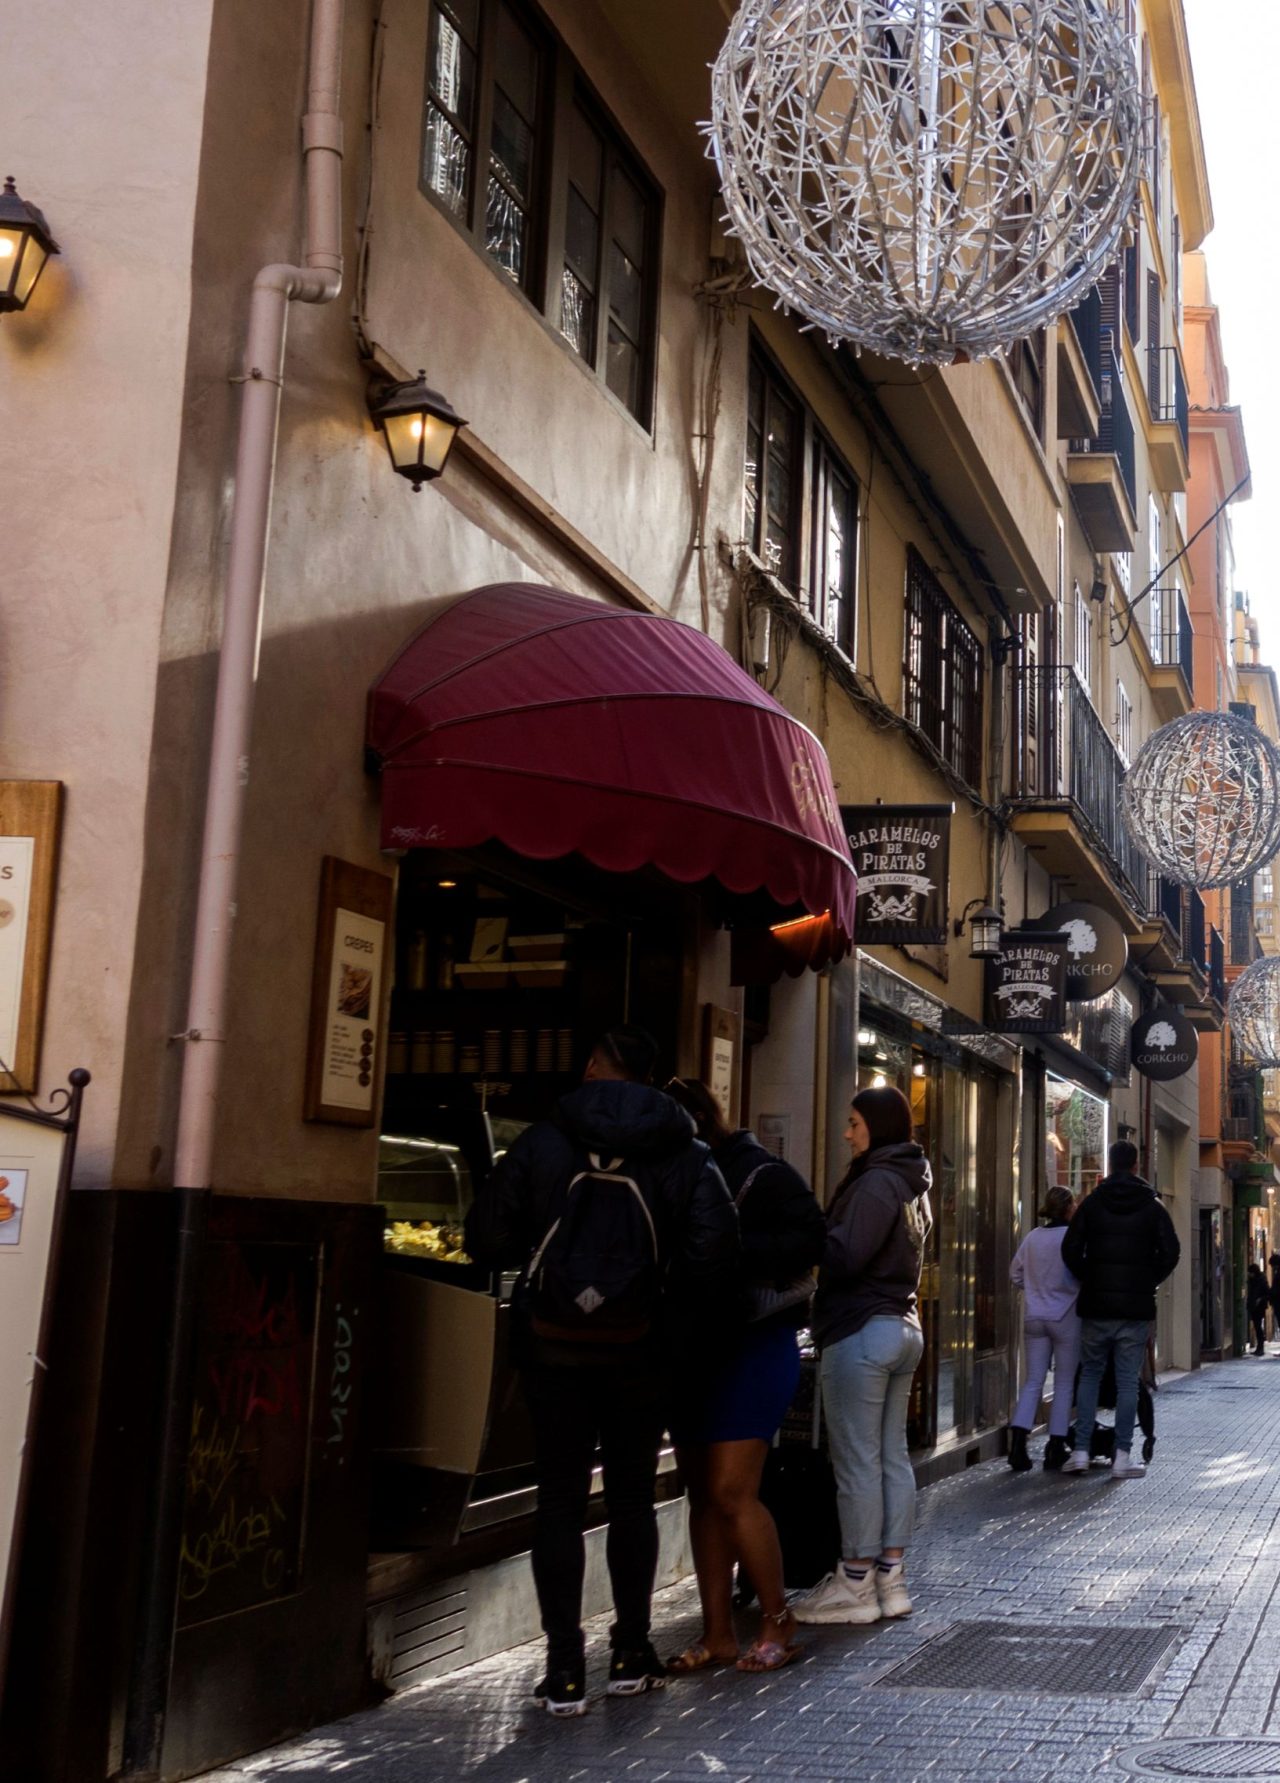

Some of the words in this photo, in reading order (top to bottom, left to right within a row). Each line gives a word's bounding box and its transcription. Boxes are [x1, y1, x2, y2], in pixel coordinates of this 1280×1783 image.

[848, 826, 941, 849] CARAMELOS
[886, 843, 903, 854] DE
[861, 852, 926, 871] PIRATAS
[867, 875, 919, 885] MALLORCA
[993, 948, 1060, 966] CARAMELOS
[1020, 960, 1033, 969] DE
[1002, 967, 1050, 981] PIRATAS
[1136, 1053, 1189, 1065] CORKCHO
